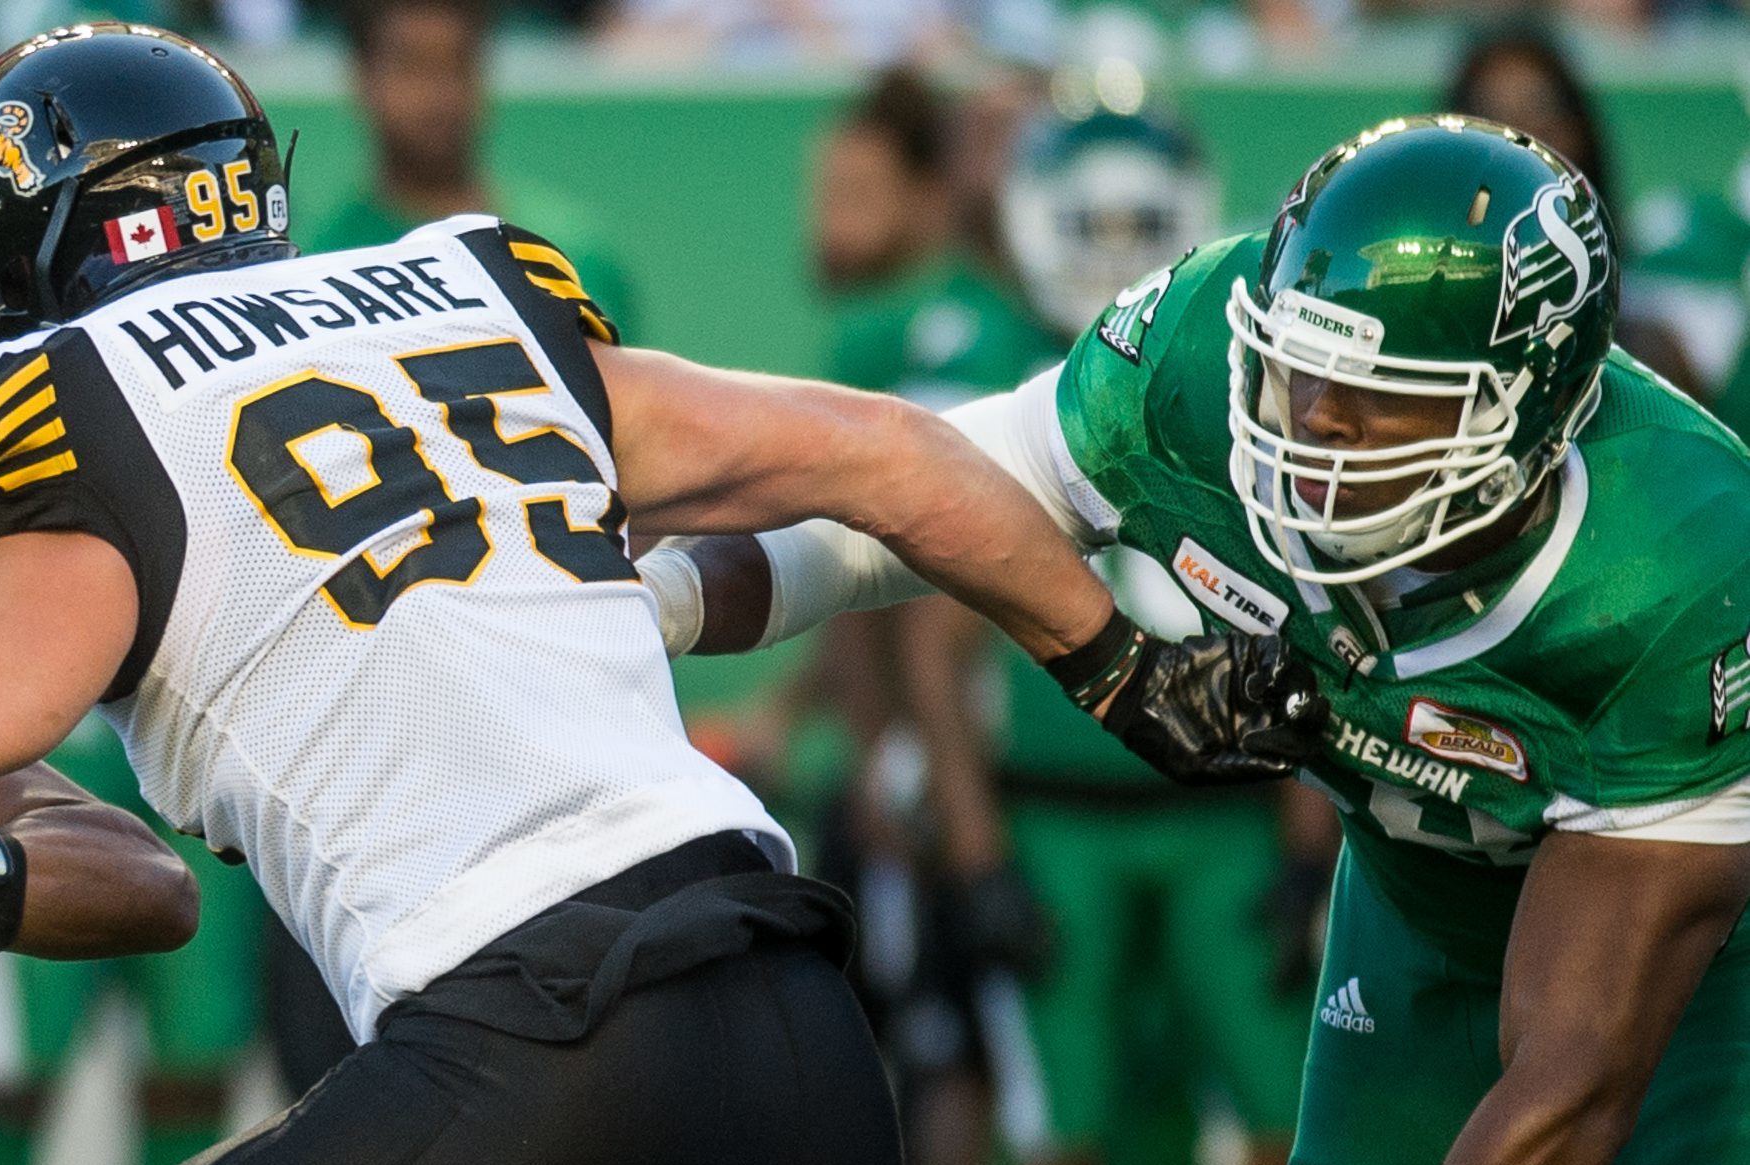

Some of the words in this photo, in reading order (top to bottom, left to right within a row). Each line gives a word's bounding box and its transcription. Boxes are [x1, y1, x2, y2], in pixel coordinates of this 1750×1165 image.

[184, 159, 260, 243] 95
[119, 256, 489, 392] HOWSARE
[1298, 305, 1355, 339] RIDERS
[224, 337, 645, 632] 95
[1178, 554, 1221, 597] KAL
[1223, 584, 1275, 632] TIRE
[1438, 735, 1506, 759] DEKALB
[1320, 1006, 1376, 1034] adidas
